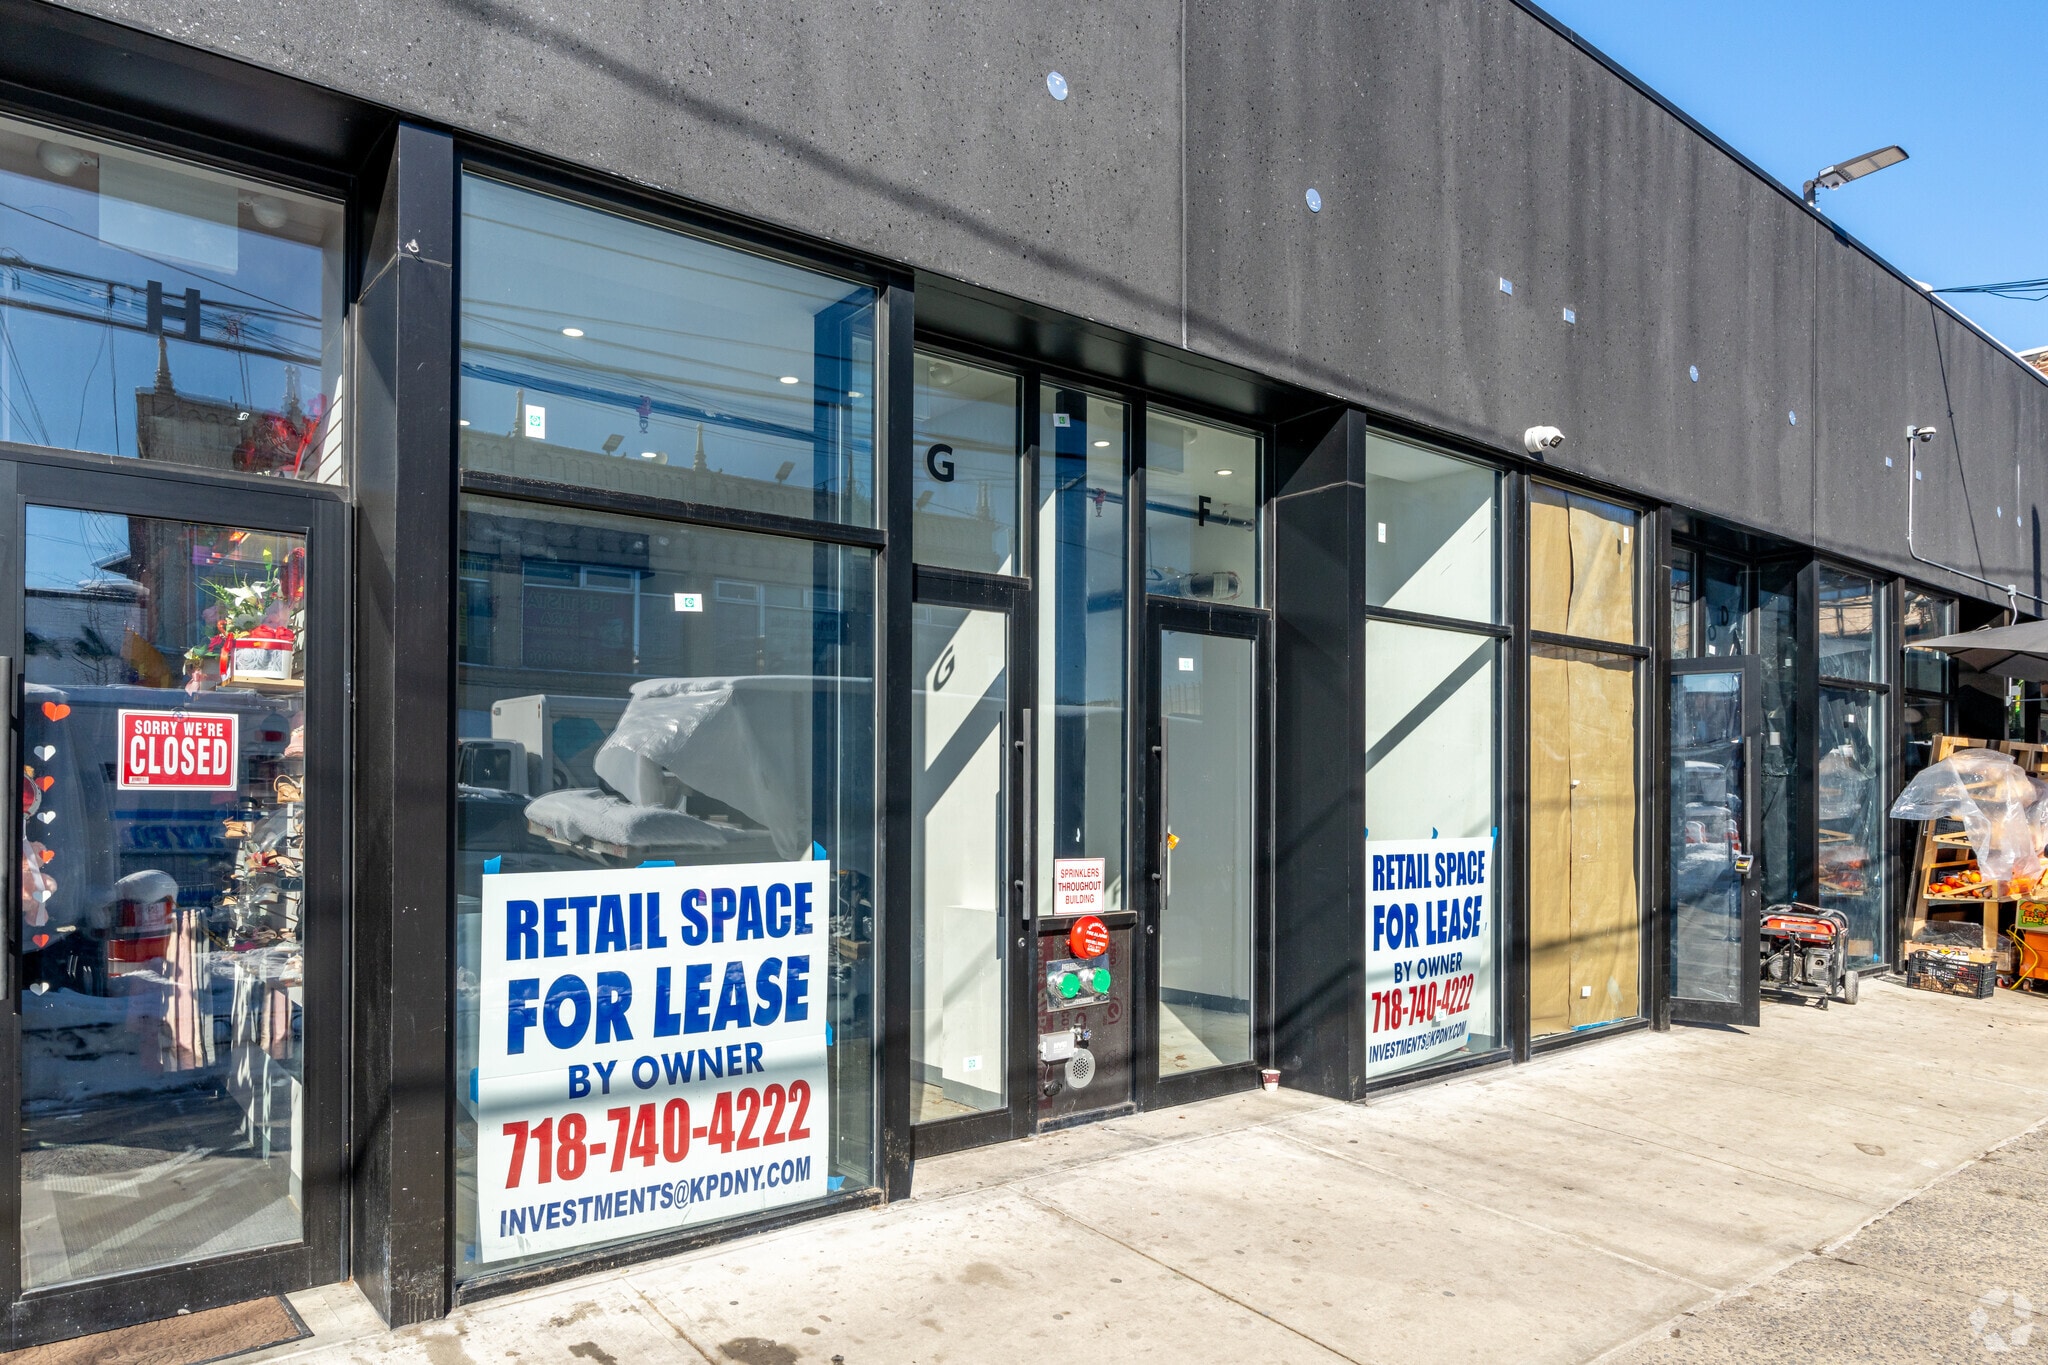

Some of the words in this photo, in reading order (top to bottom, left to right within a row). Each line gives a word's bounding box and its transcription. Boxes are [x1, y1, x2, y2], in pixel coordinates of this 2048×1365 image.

[147, 280, 200, 341] H
[926, 443, 955, 483] G
[1198, 495, 1212, 527] F
[1720, 605, 1729, 627] D
[134, 719, 178, 736] SORRY
[183, 721, 224, 737] WE'RE
[129, 735, 228, 776] CLOSED
[1057, 880, 1102, 892] THROUGHOUT
[1060, 867, 1100, 879] SPRINKLERS
[1372, 852, 1432, 892] RETAIL
[1434, 850, 1486, 889] SPACE
[1065, 893, 1095, 905] BUILDING
[505, 891, 668, 962] RETAIL
[680, 881, 814, 947] SPACE
[1373, 902, 1420, 952] FOR
[1425, 894, 1483, 946] LEASE
[1393, 959, 1413, 984] BY
[1417, 951, 1463, 980] OWNER
[506, 970, 634, 1056] FOR
[653, 954, 811, 1039] LEASE
[1371, 972, 1475, 1034] 718-740-4222
[1368, 1020, 1468, 1065] INVESTMENTS@KPDNY.COM
[568, 1059, 619, 1100] BY
[630, 1041, 766, 1090] OWNER
[502, 1079, 812, 1190] 718-740-4222
[499, 1155, 812, 1238] INVESTMENTS@KPDNY.COM
